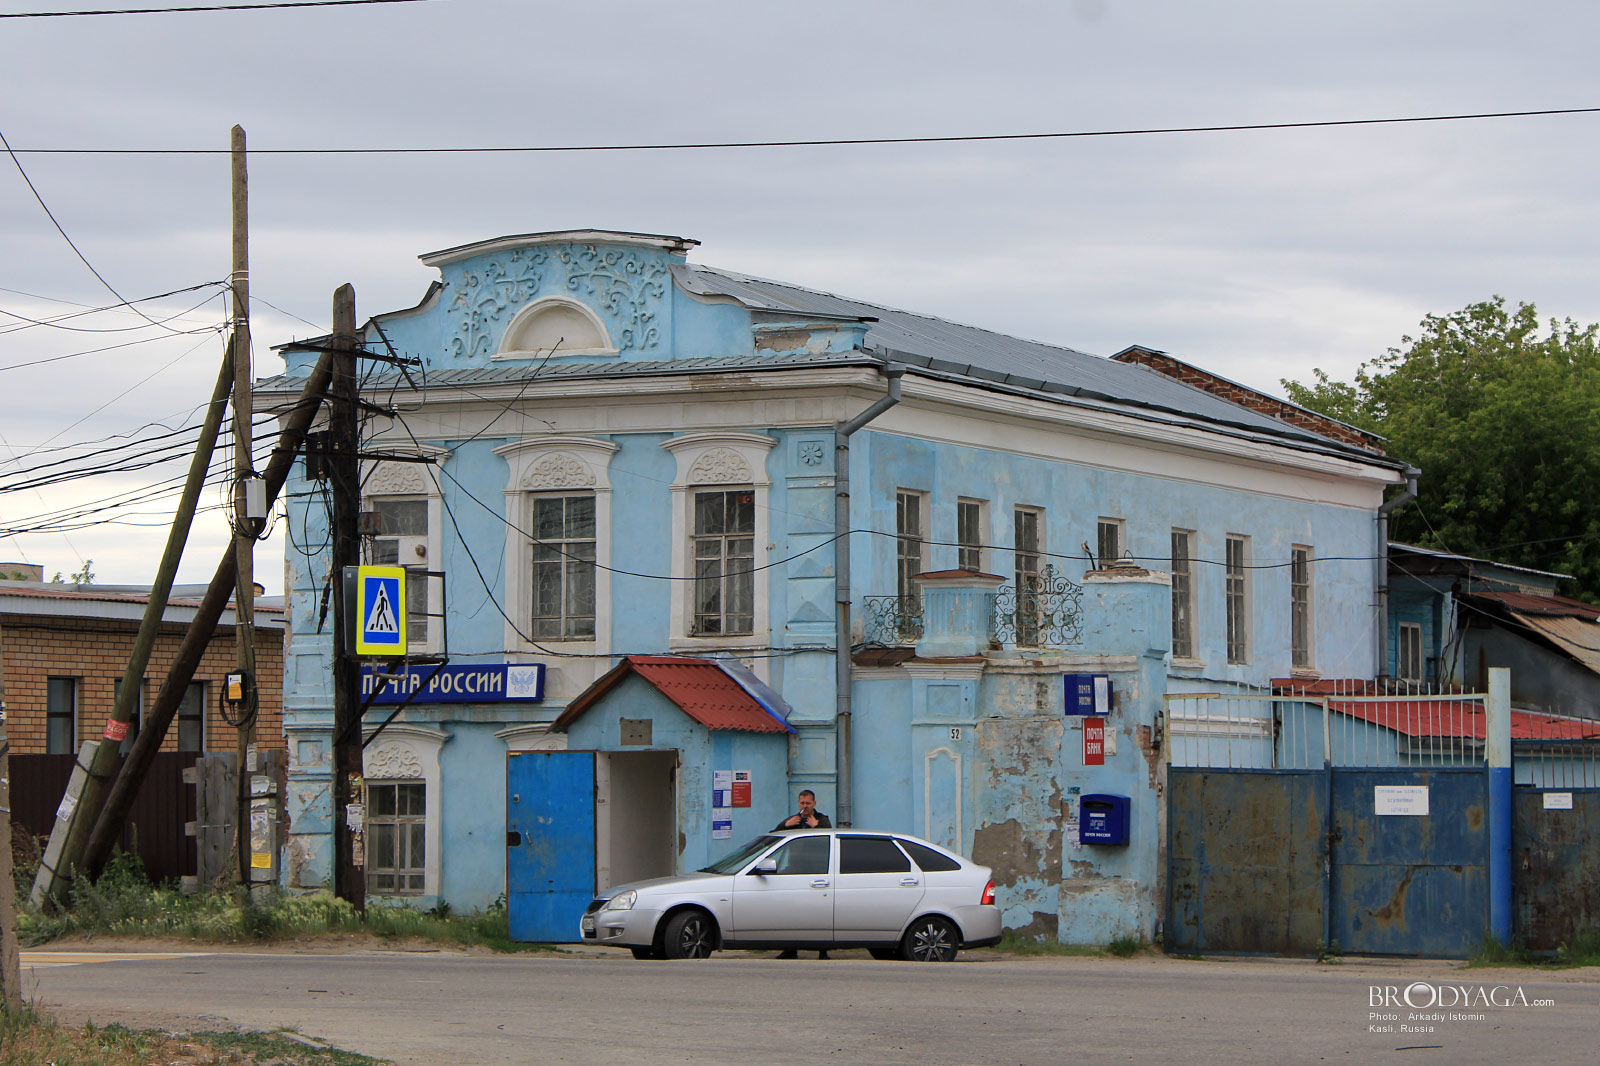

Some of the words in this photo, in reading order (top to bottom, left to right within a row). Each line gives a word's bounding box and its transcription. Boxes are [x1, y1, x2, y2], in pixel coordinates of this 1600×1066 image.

[429, 672, 502, 693] РОССИИ
[1078, 684, 1091, 694] ПОЧТА
[951, 728, 960, 740] 52
[1086, 727, 1103, 740] ПОЧТА
[1086, 742, 1102, 755] БАНК
